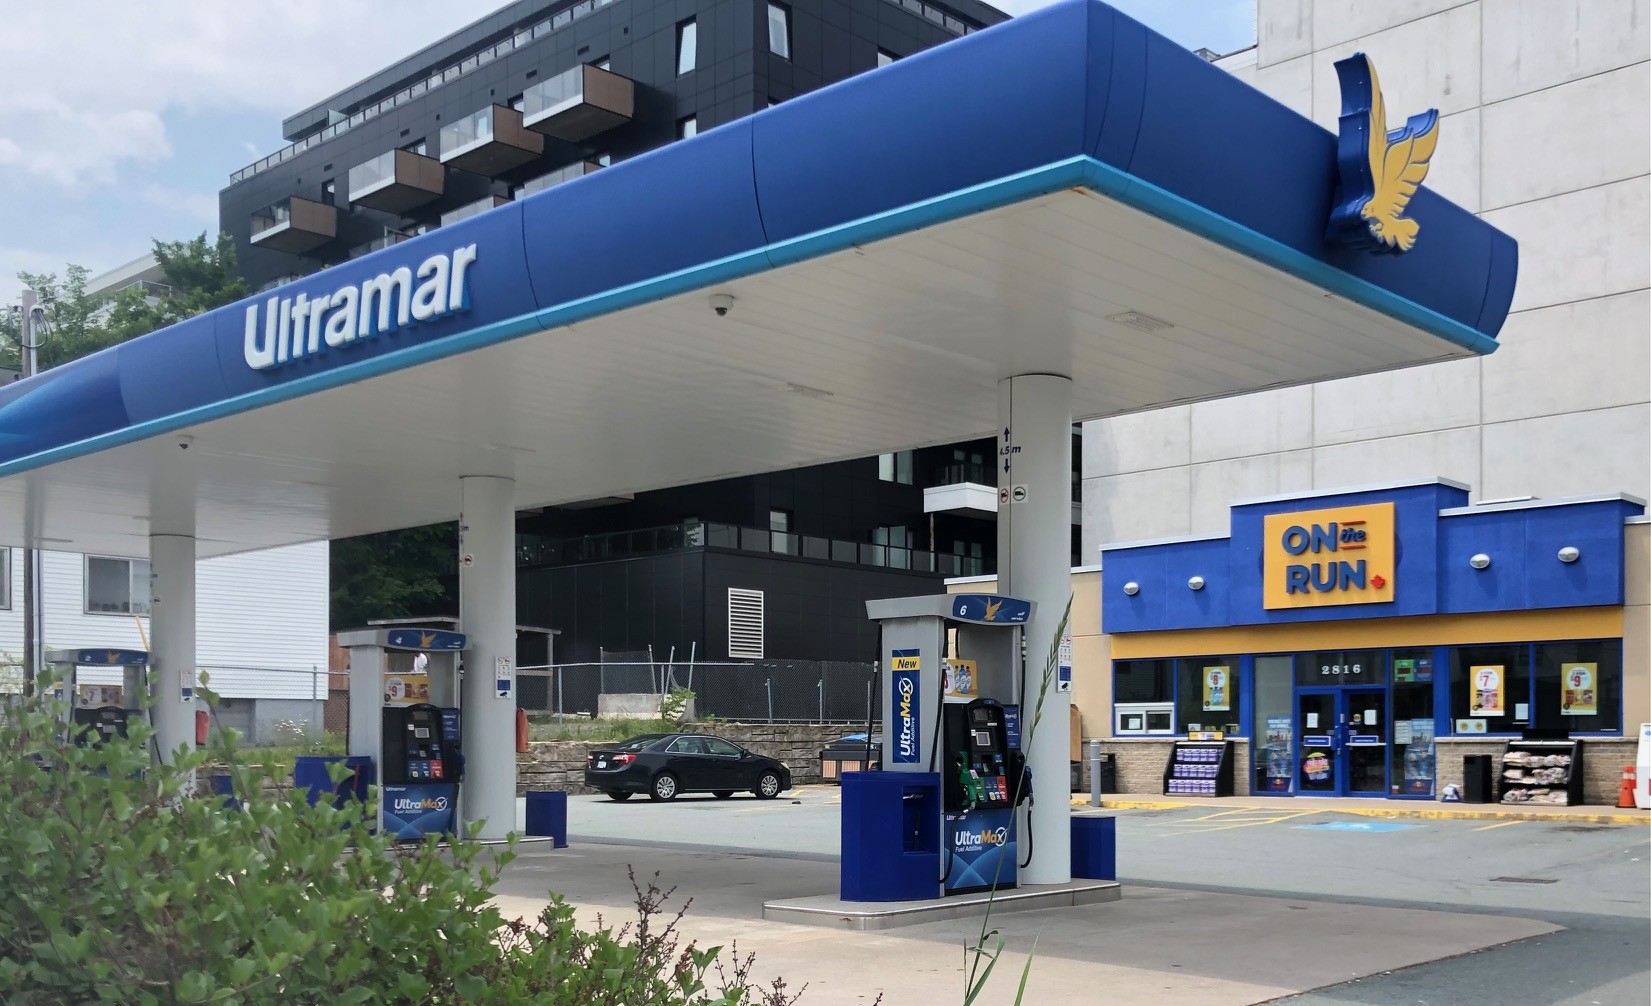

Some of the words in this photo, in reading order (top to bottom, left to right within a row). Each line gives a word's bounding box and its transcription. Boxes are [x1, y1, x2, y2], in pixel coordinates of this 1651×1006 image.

[244, 243, 477, 370] Ultramar
[1282, 522, 1338, 555] ON
[1340, 528, 1367, 542] the
[1286, 560, 1366, 594] RUN
[960, 605, 967, 615] 6
[897, 658, 917, 669] New
[1321, 664, 1361, 675] 2816
[898, 677, 912, 756] UltraMax
[394, 796, 448, 811] UltraMax
[955, 826, 1007, 847] UltraMax
